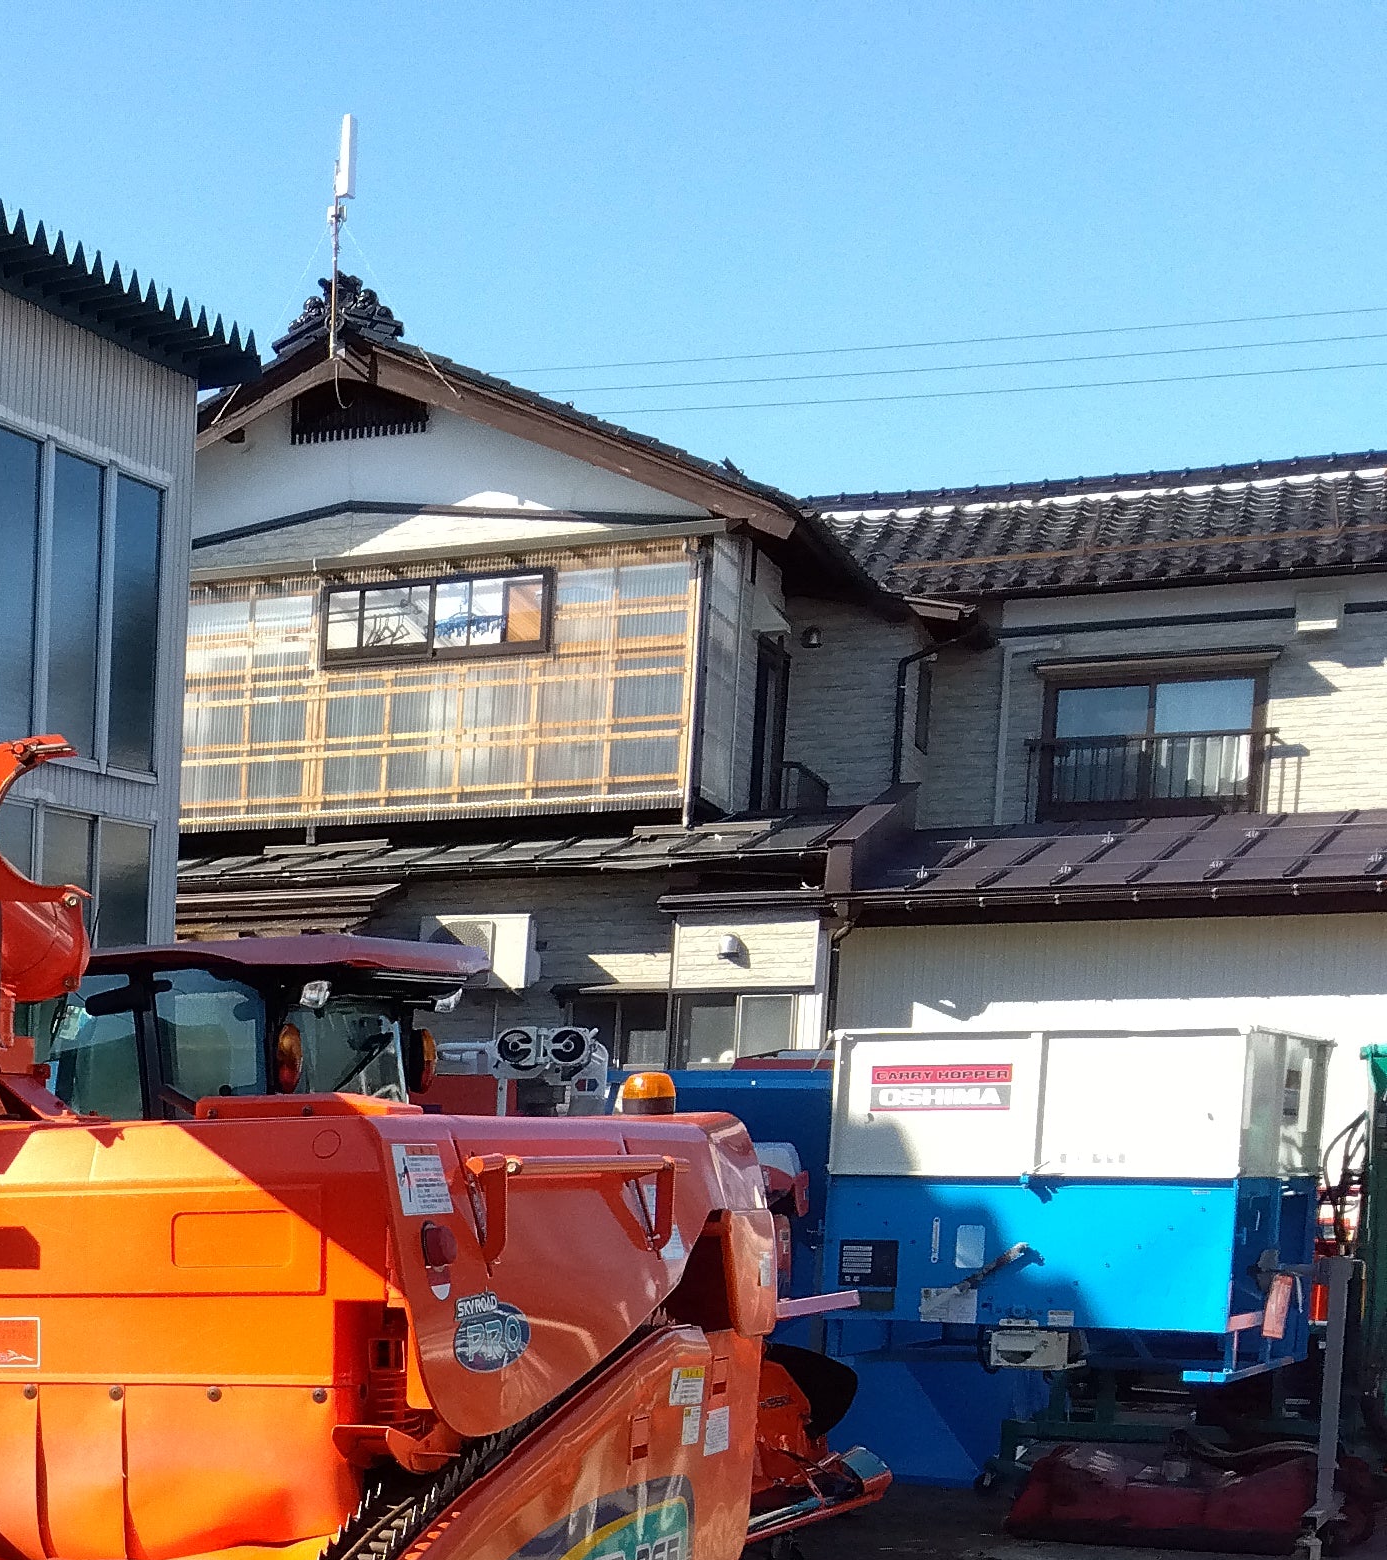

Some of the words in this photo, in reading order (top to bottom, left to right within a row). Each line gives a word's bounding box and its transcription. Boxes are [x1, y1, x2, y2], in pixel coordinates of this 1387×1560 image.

[876, 1071, 933, 1080] CARRY
[937, 1070, 1009, 1080] HOPPER
[878, 1087, 1002, 1106] OSHIMA
[466, 1315, 522, 1362] PRO
